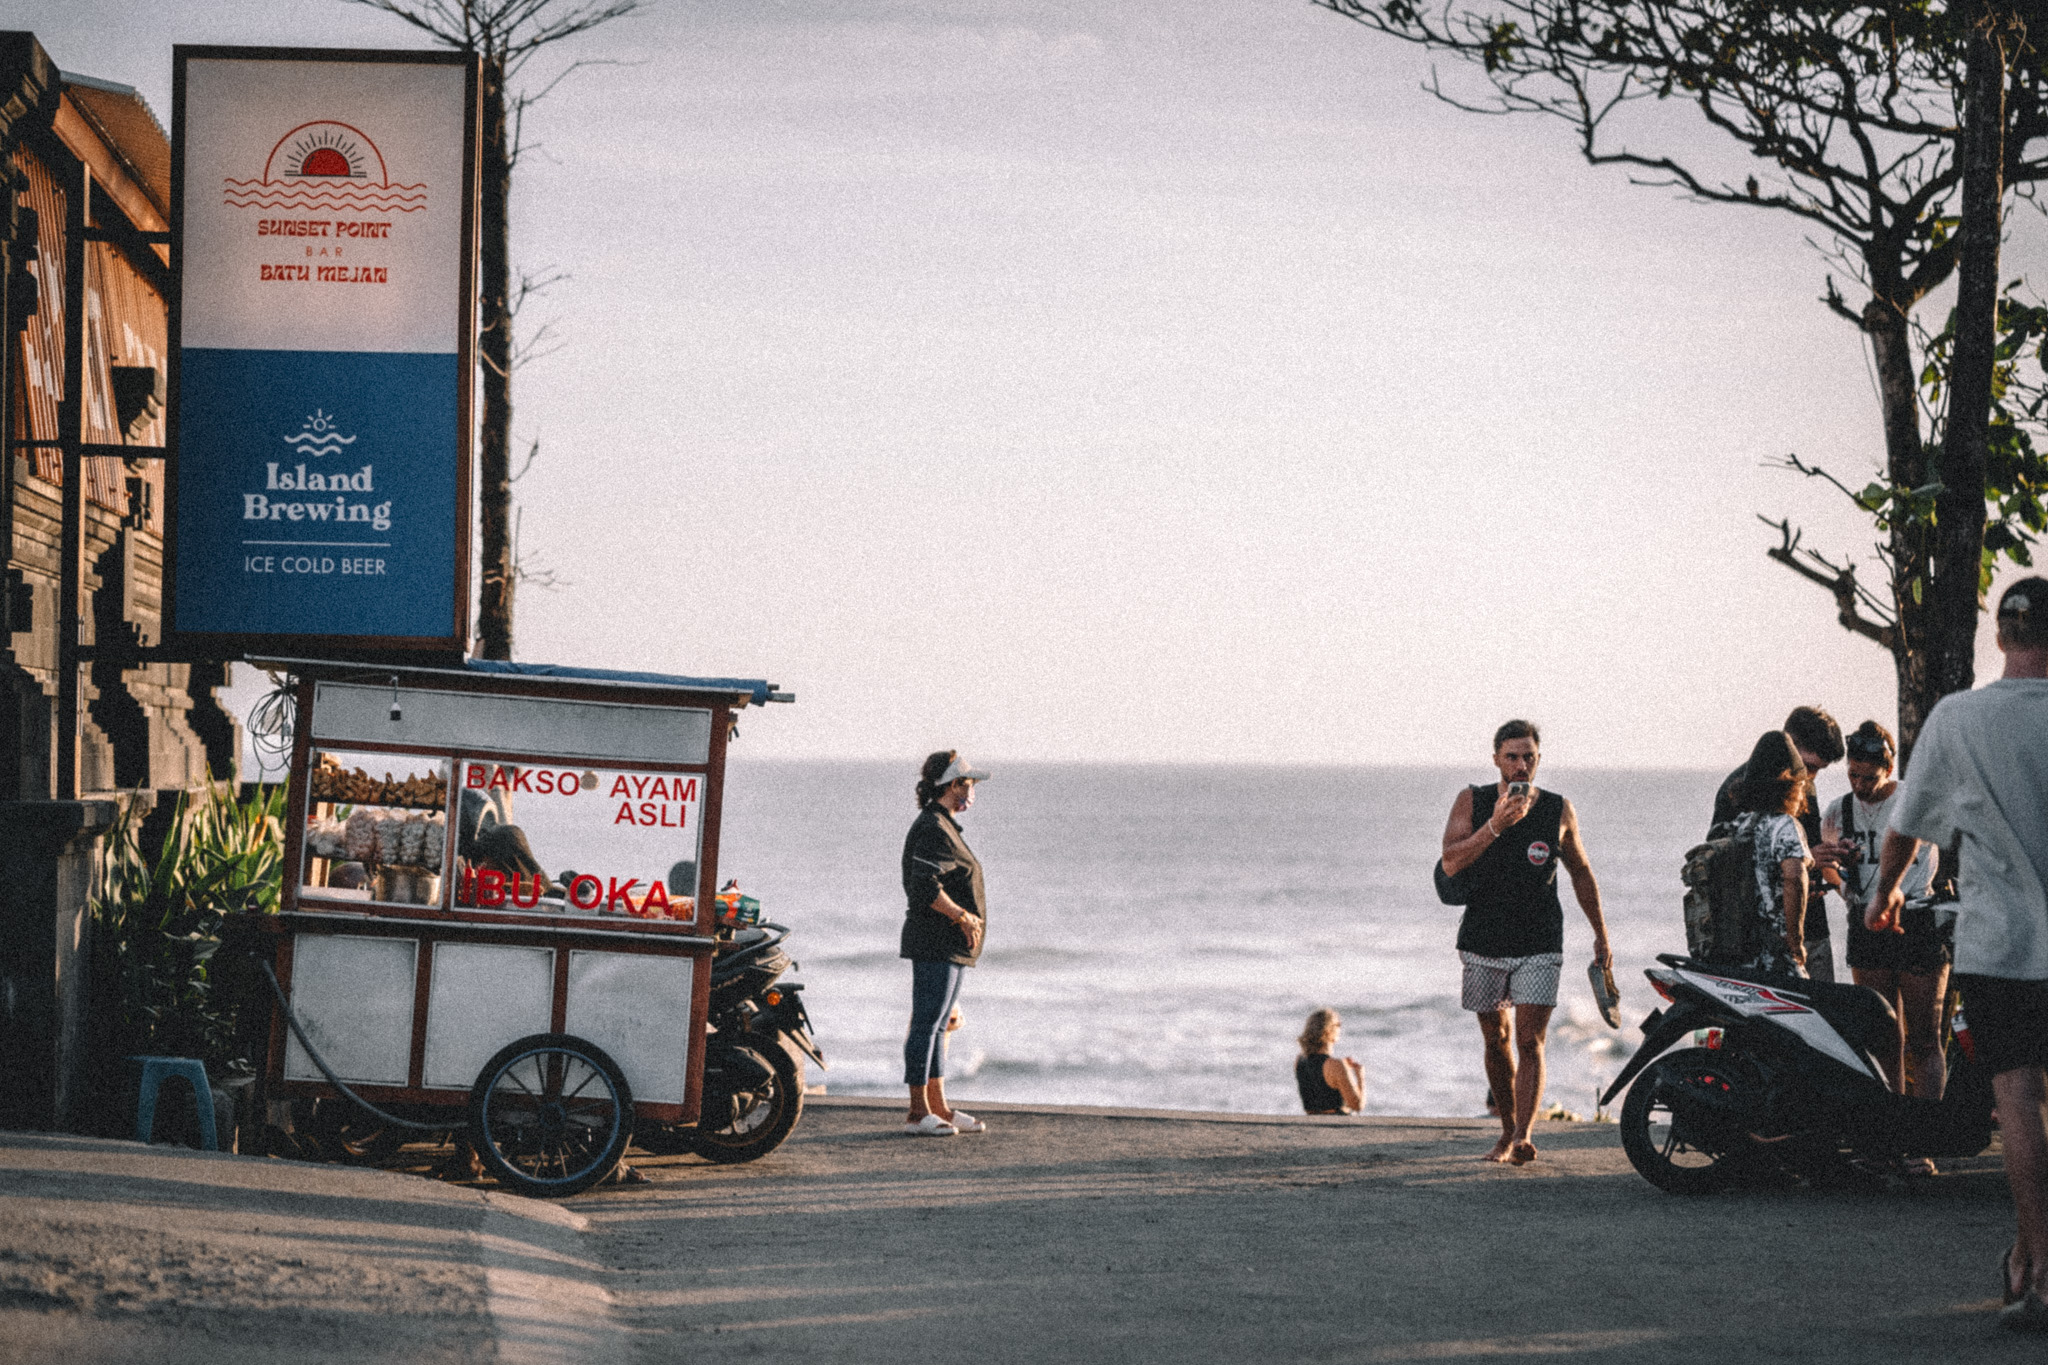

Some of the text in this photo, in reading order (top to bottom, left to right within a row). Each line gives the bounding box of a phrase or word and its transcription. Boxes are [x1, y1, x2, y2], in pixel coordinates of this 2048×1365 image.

[258, 219, 392, 238] SUNSET POINT
[306, 246, 343, 257] BAR
[260, 264, 388, 283] BATU MEJAN
[266, 462, 374, 492] Island
[243, 493, 392, 531] Brewing
[245, 556, 386, 575] ICE COLD BEER
[466, 765, 697, 802] BAKSO AYAM
[614, 802, 686, 828] ASLI
[461, 867, 674, 917] IBU OKA
